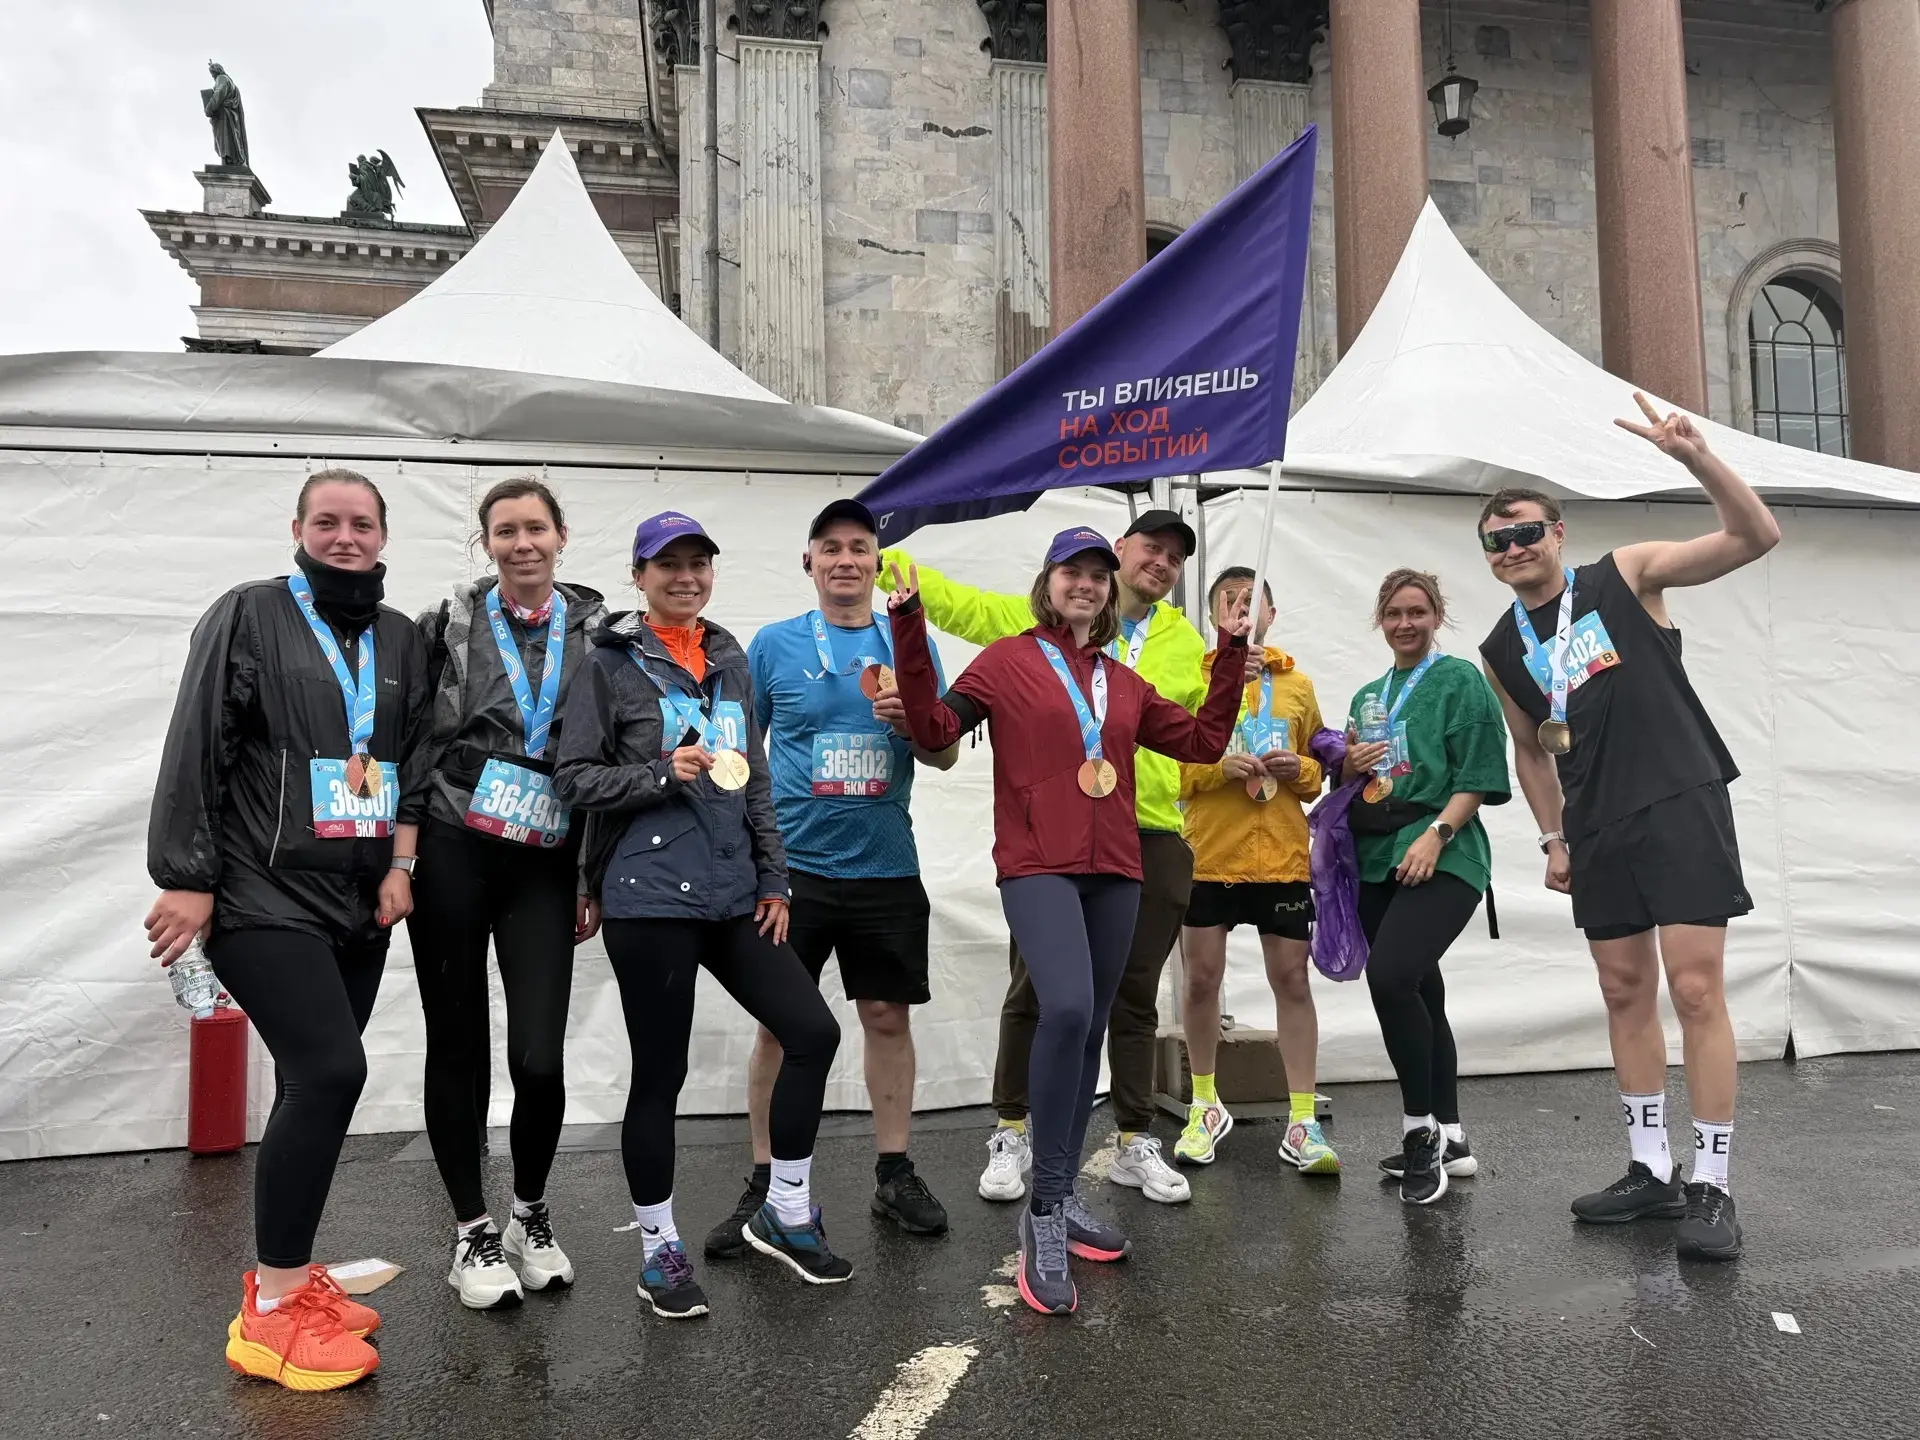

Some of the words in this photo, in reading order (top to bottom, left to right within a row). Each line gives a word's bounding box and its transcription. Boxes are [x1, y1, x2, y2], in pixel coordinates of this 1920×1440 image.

[1062, 386, 1105, 412] ТЫ
[1114, 366, 1259, 405] ВЛИЯЕШЬ
[1059, 414, 1099, 441] НА
[1107, 406, 1170, 436] ХОД
[1058, 426, 1209, 469] СОБЫТИЙ
[303, 601, 320, 621] ПСБ
[553, 612, 562, 630] ПСБ
[494, 621, 508, 640] ПСБ
[1602, 652, 1614, 663] B
[821, 749, 887, 779] 36502
[869, 782, 878, 792] E
[482, 779, 562, 831] 36490
[543, 832, 556, 844] D
